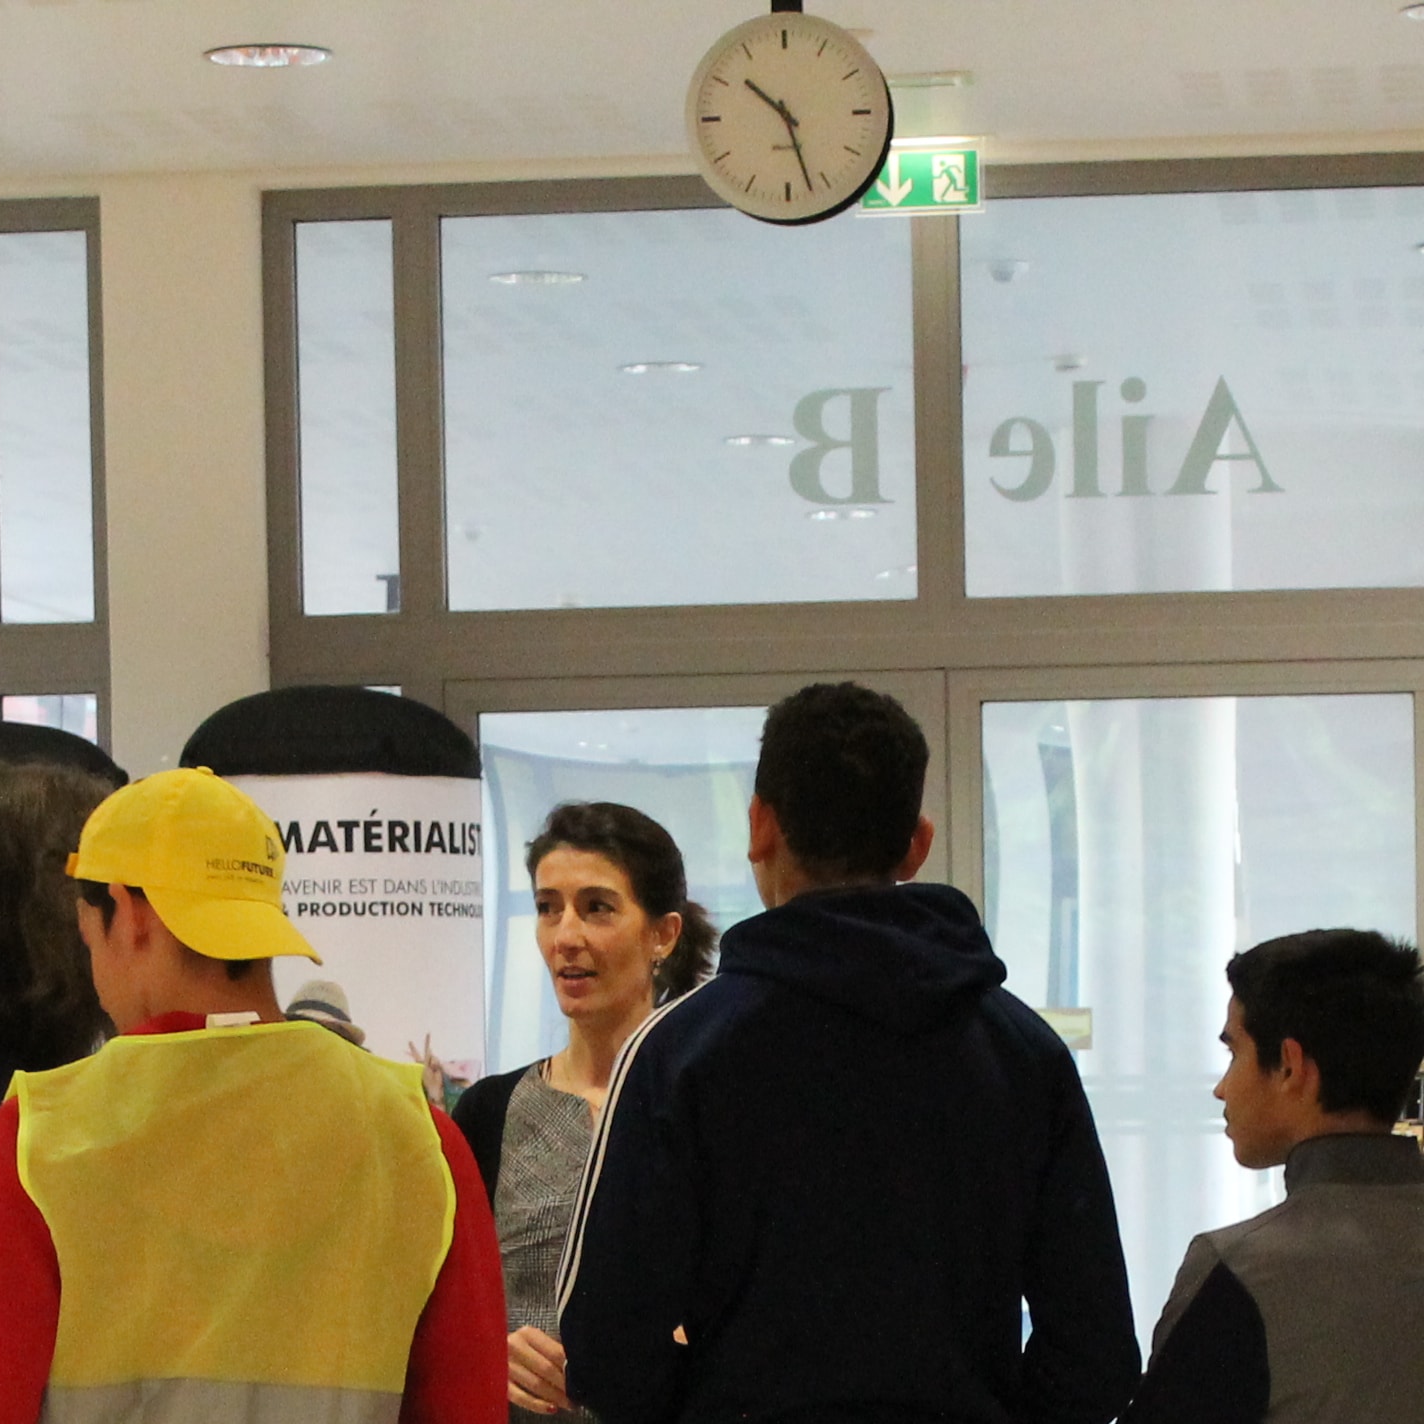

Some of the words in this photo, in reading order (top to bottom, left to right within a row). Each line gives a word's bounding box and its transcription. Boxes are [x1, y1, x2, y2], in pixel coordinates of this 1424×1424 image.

[349, 879, 377, 895] EST
[384, 879, 427, 895] DANS
[297, 901, 423, 917] PRODUCTION
